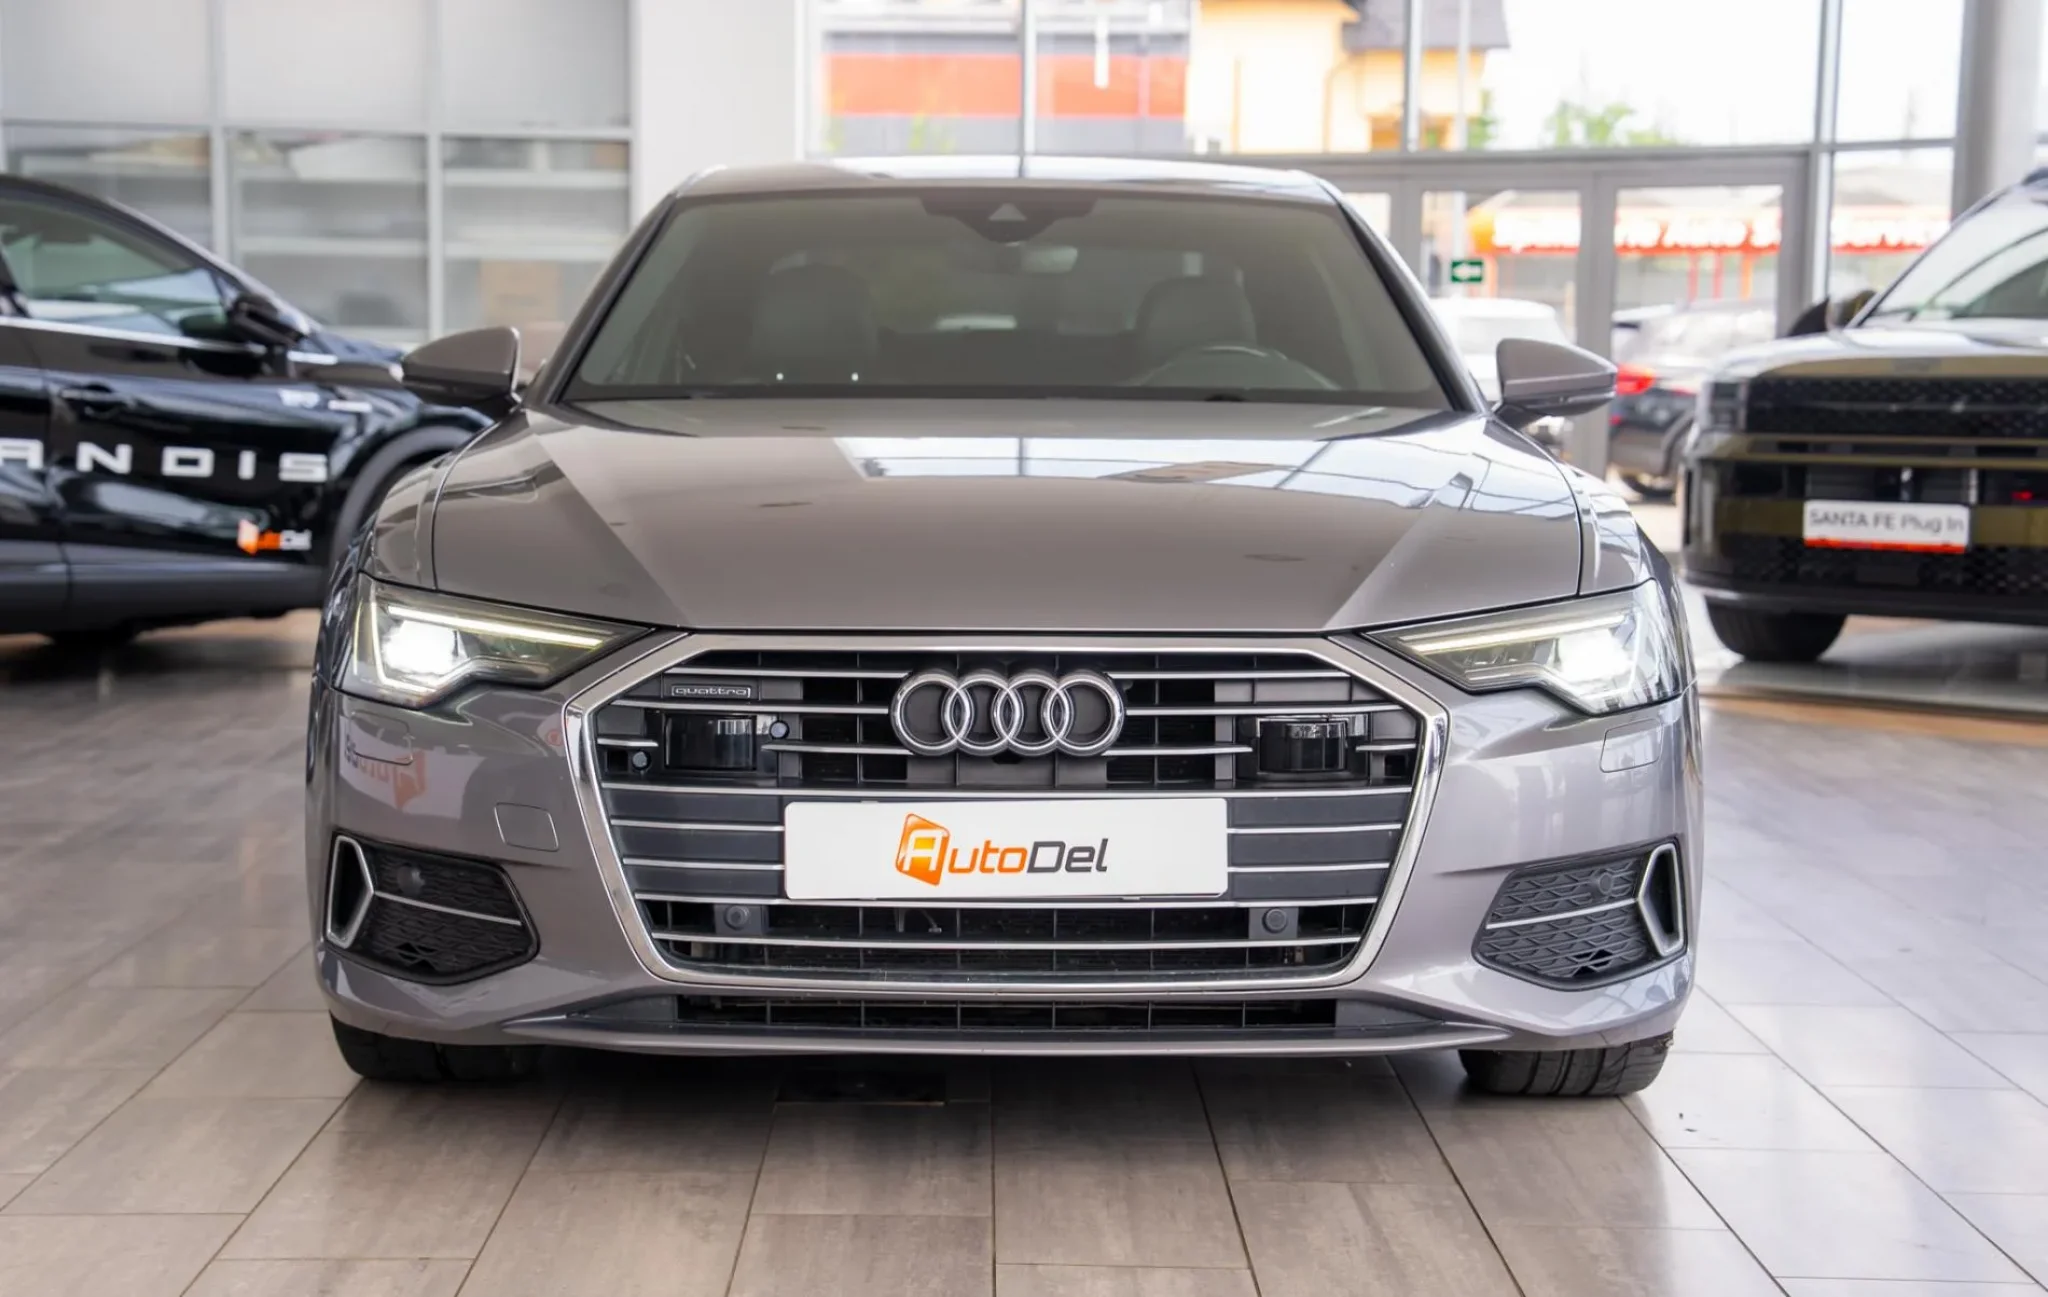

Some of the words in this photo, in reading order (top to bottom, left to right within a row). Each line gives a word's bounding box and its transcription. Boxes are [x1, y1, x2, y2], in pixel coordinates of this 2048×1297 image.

[1809, 508, 1868, 527] SANTA
[1873, 511, 1896, 529] FE
[1901, 513, 1942, 533] Plug
[1947, 516, 1964, 532] In
[675, 687, 747, 697] quattro
[900, 823, 1109, 878] AutoDel
